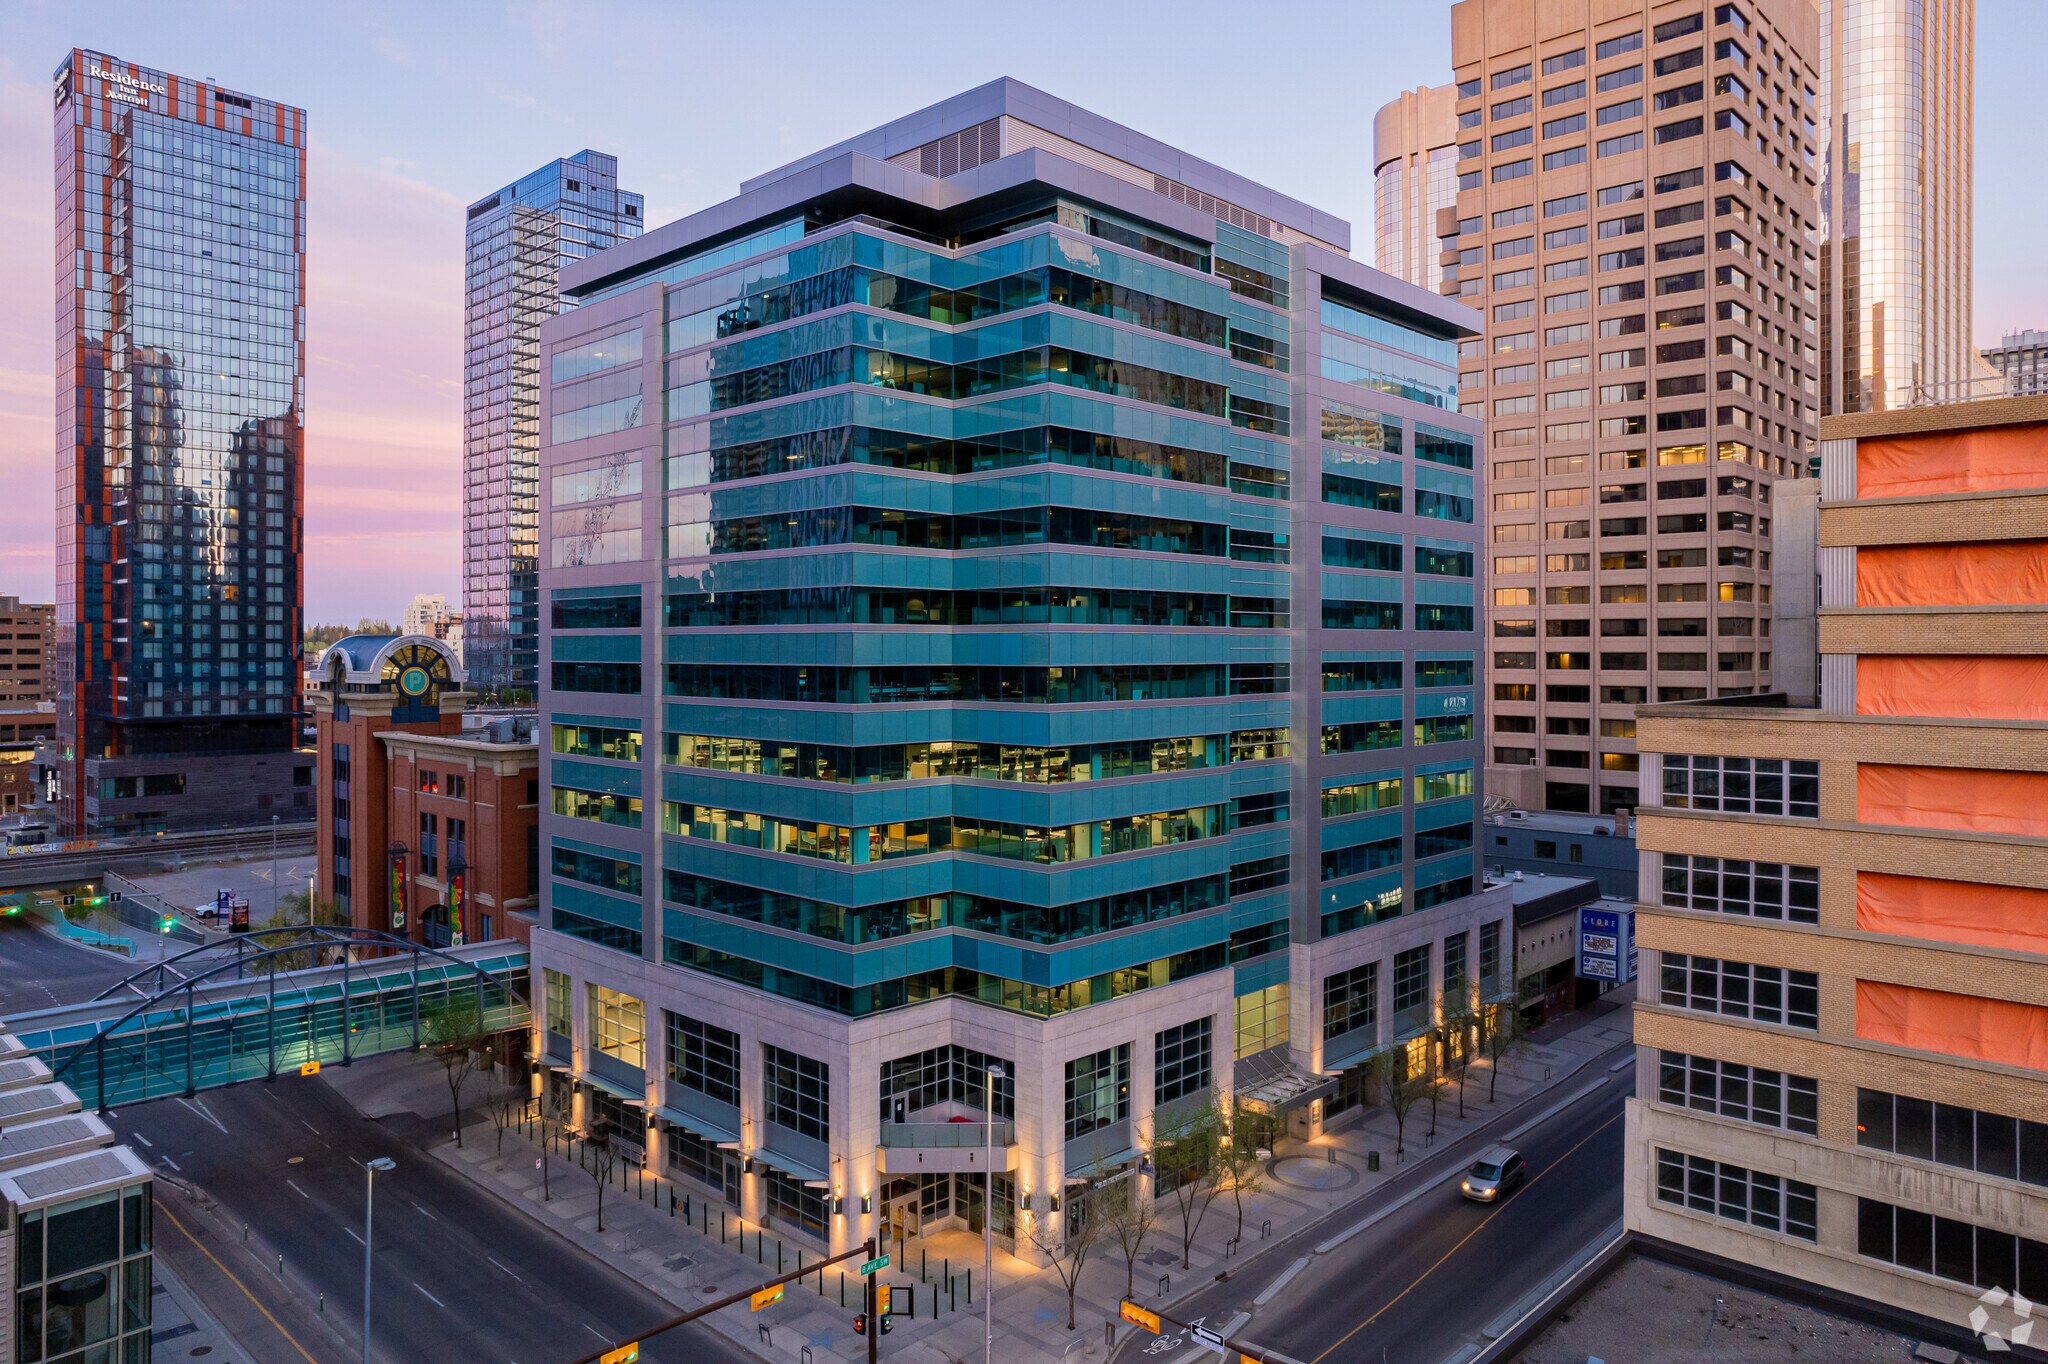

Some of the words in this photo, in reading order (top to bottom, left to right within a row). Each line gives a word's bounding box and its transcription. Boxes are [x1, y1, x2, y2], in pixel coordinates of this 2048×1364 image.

[90, 65, 165, 94] Residence
[120, 84, 138, 95] Inn
[106, 90, 148, 107] Marriott
[410, 673, 421, 690] P
[1583, 917, 1616, 928] GLOBE
[867, 1261, 877, 1271] AVE
[880, 1258, 888, 1266] SW
